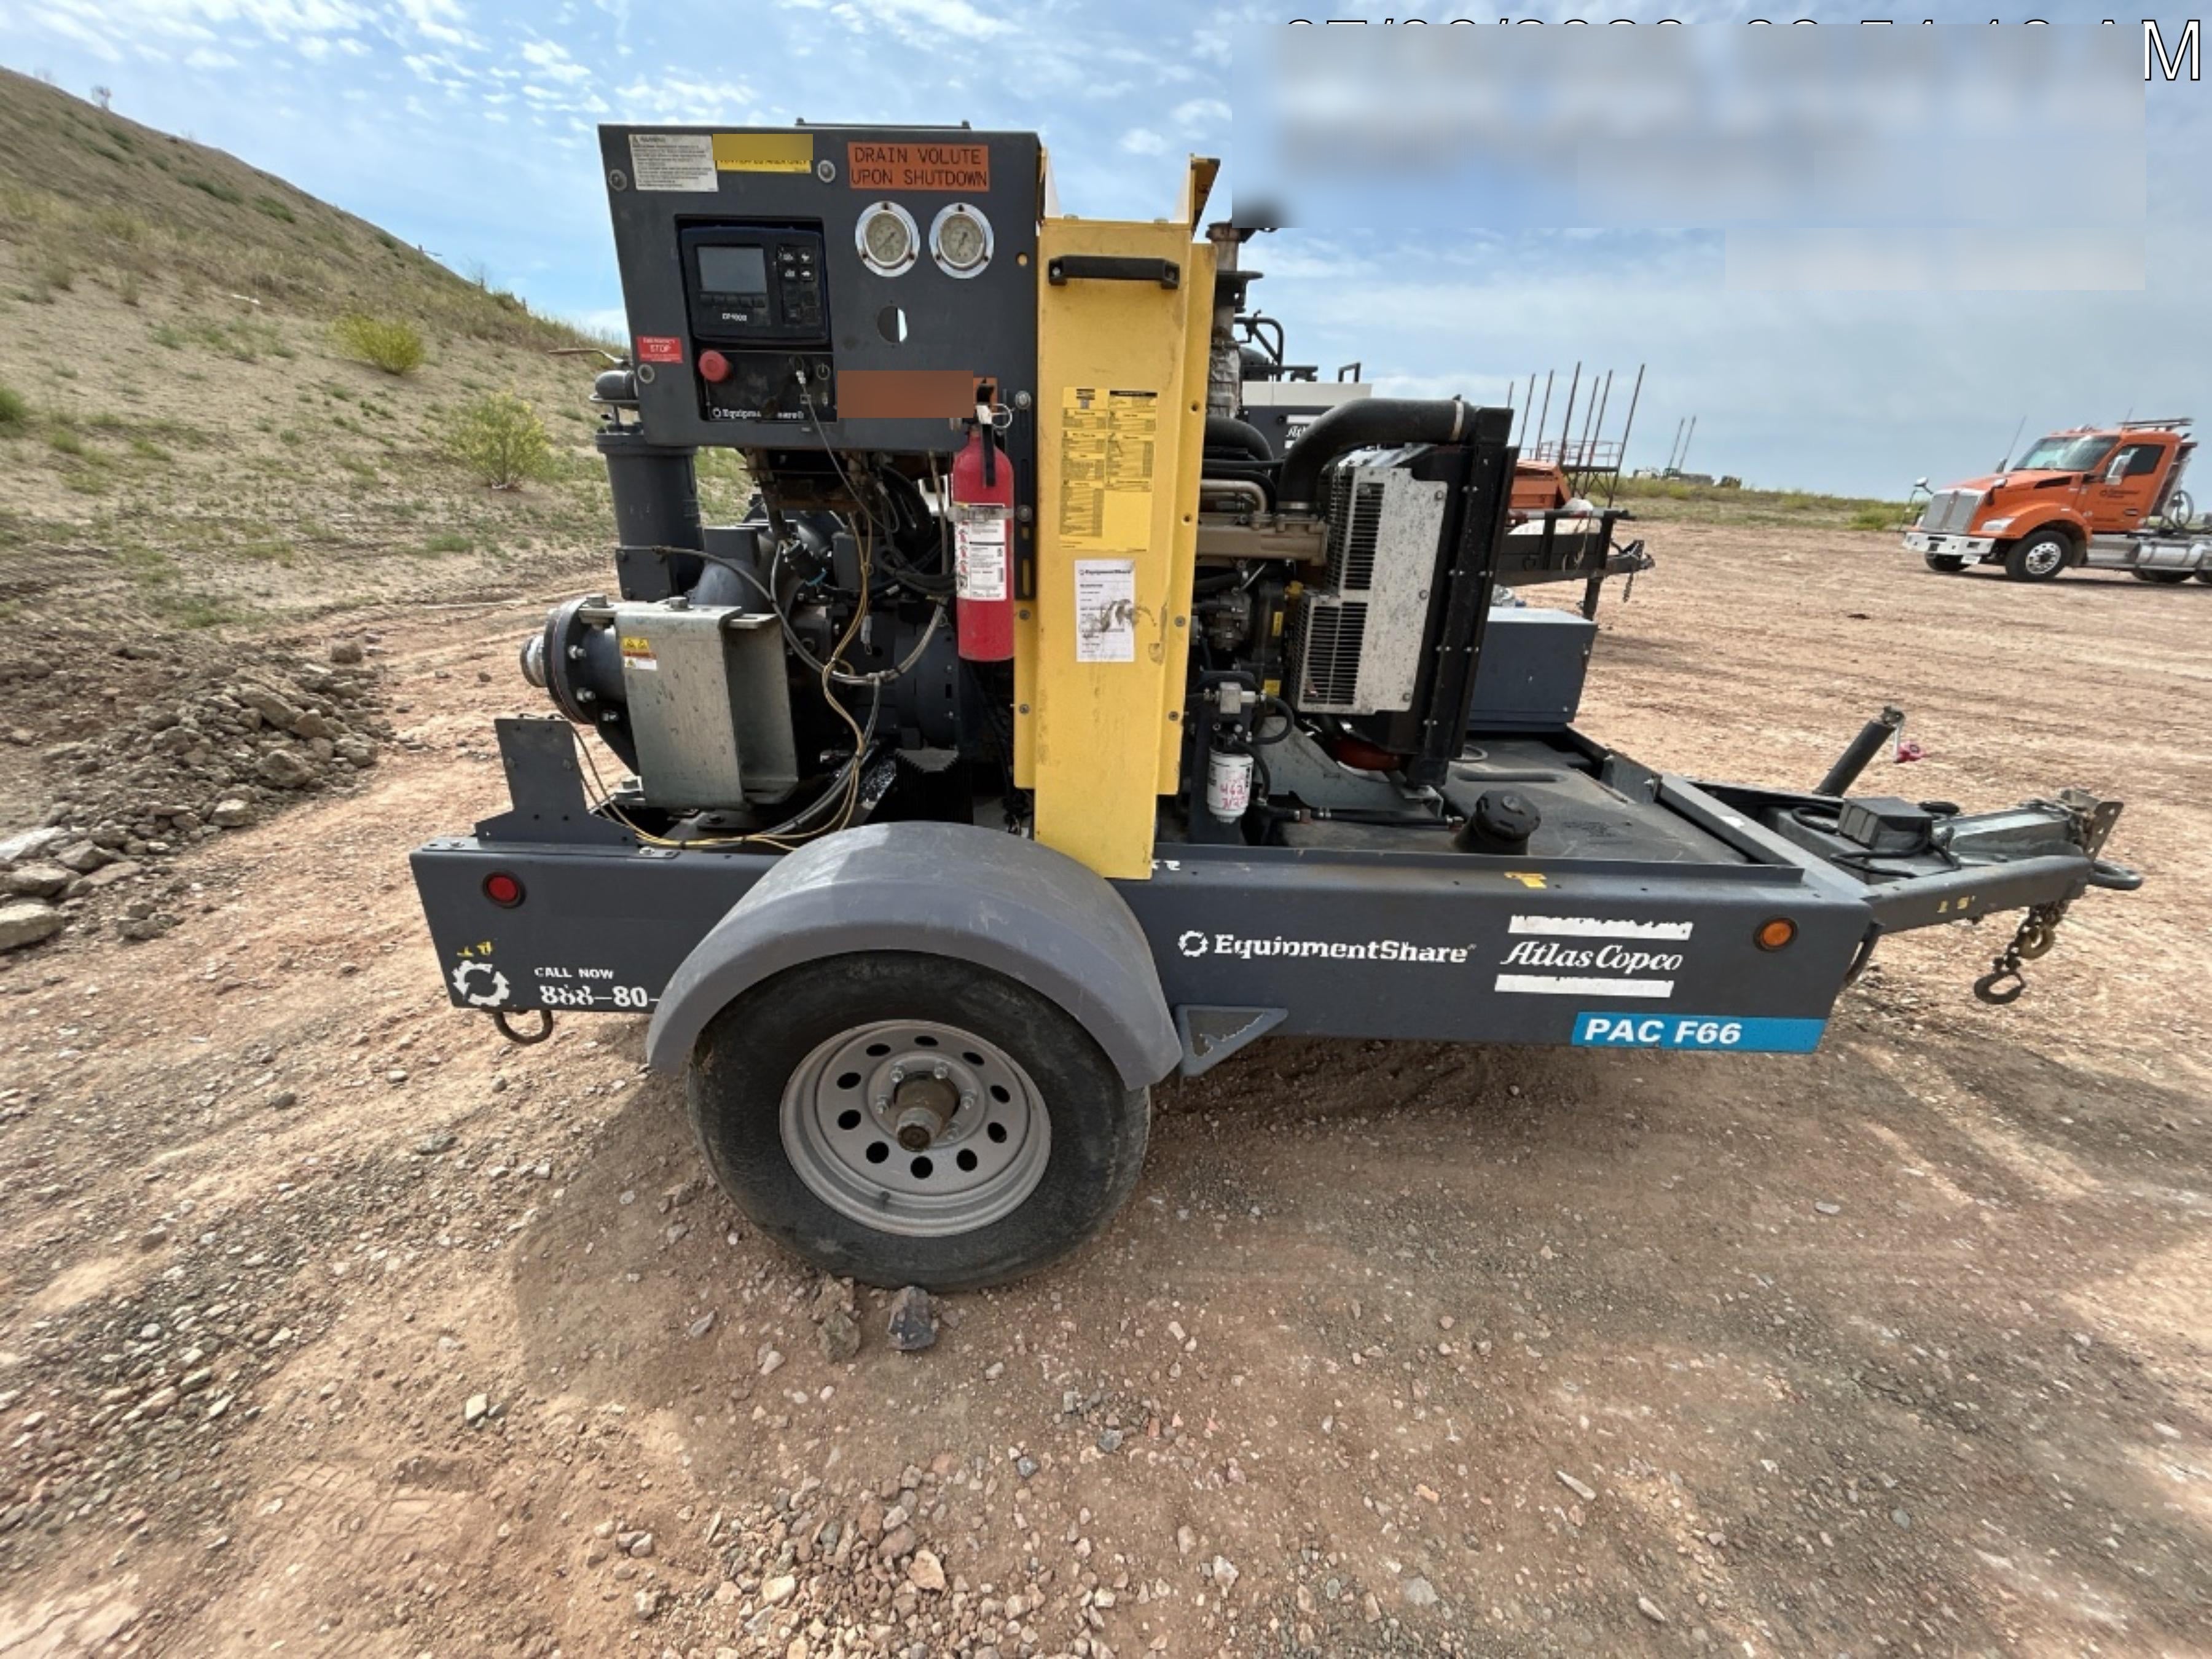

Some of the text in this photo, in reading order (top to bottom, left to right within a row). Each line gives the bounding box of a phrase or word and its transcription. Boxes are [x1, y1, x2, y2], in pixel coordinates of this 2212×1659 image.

[854, 146, 982, 165] DRAIN VOLUTE
[850, 168, 988, 187] UPON SHUTDOWN
[650, 344, 671, 353] STOP
[1214, 934, 1468, 963] EquipmentShare
[1499, 941, 1684, 975] Atlas Copco
[534, 967, 614, 979] CALL NOW
[1585, 1019, 1742, 1044] PAC F66
